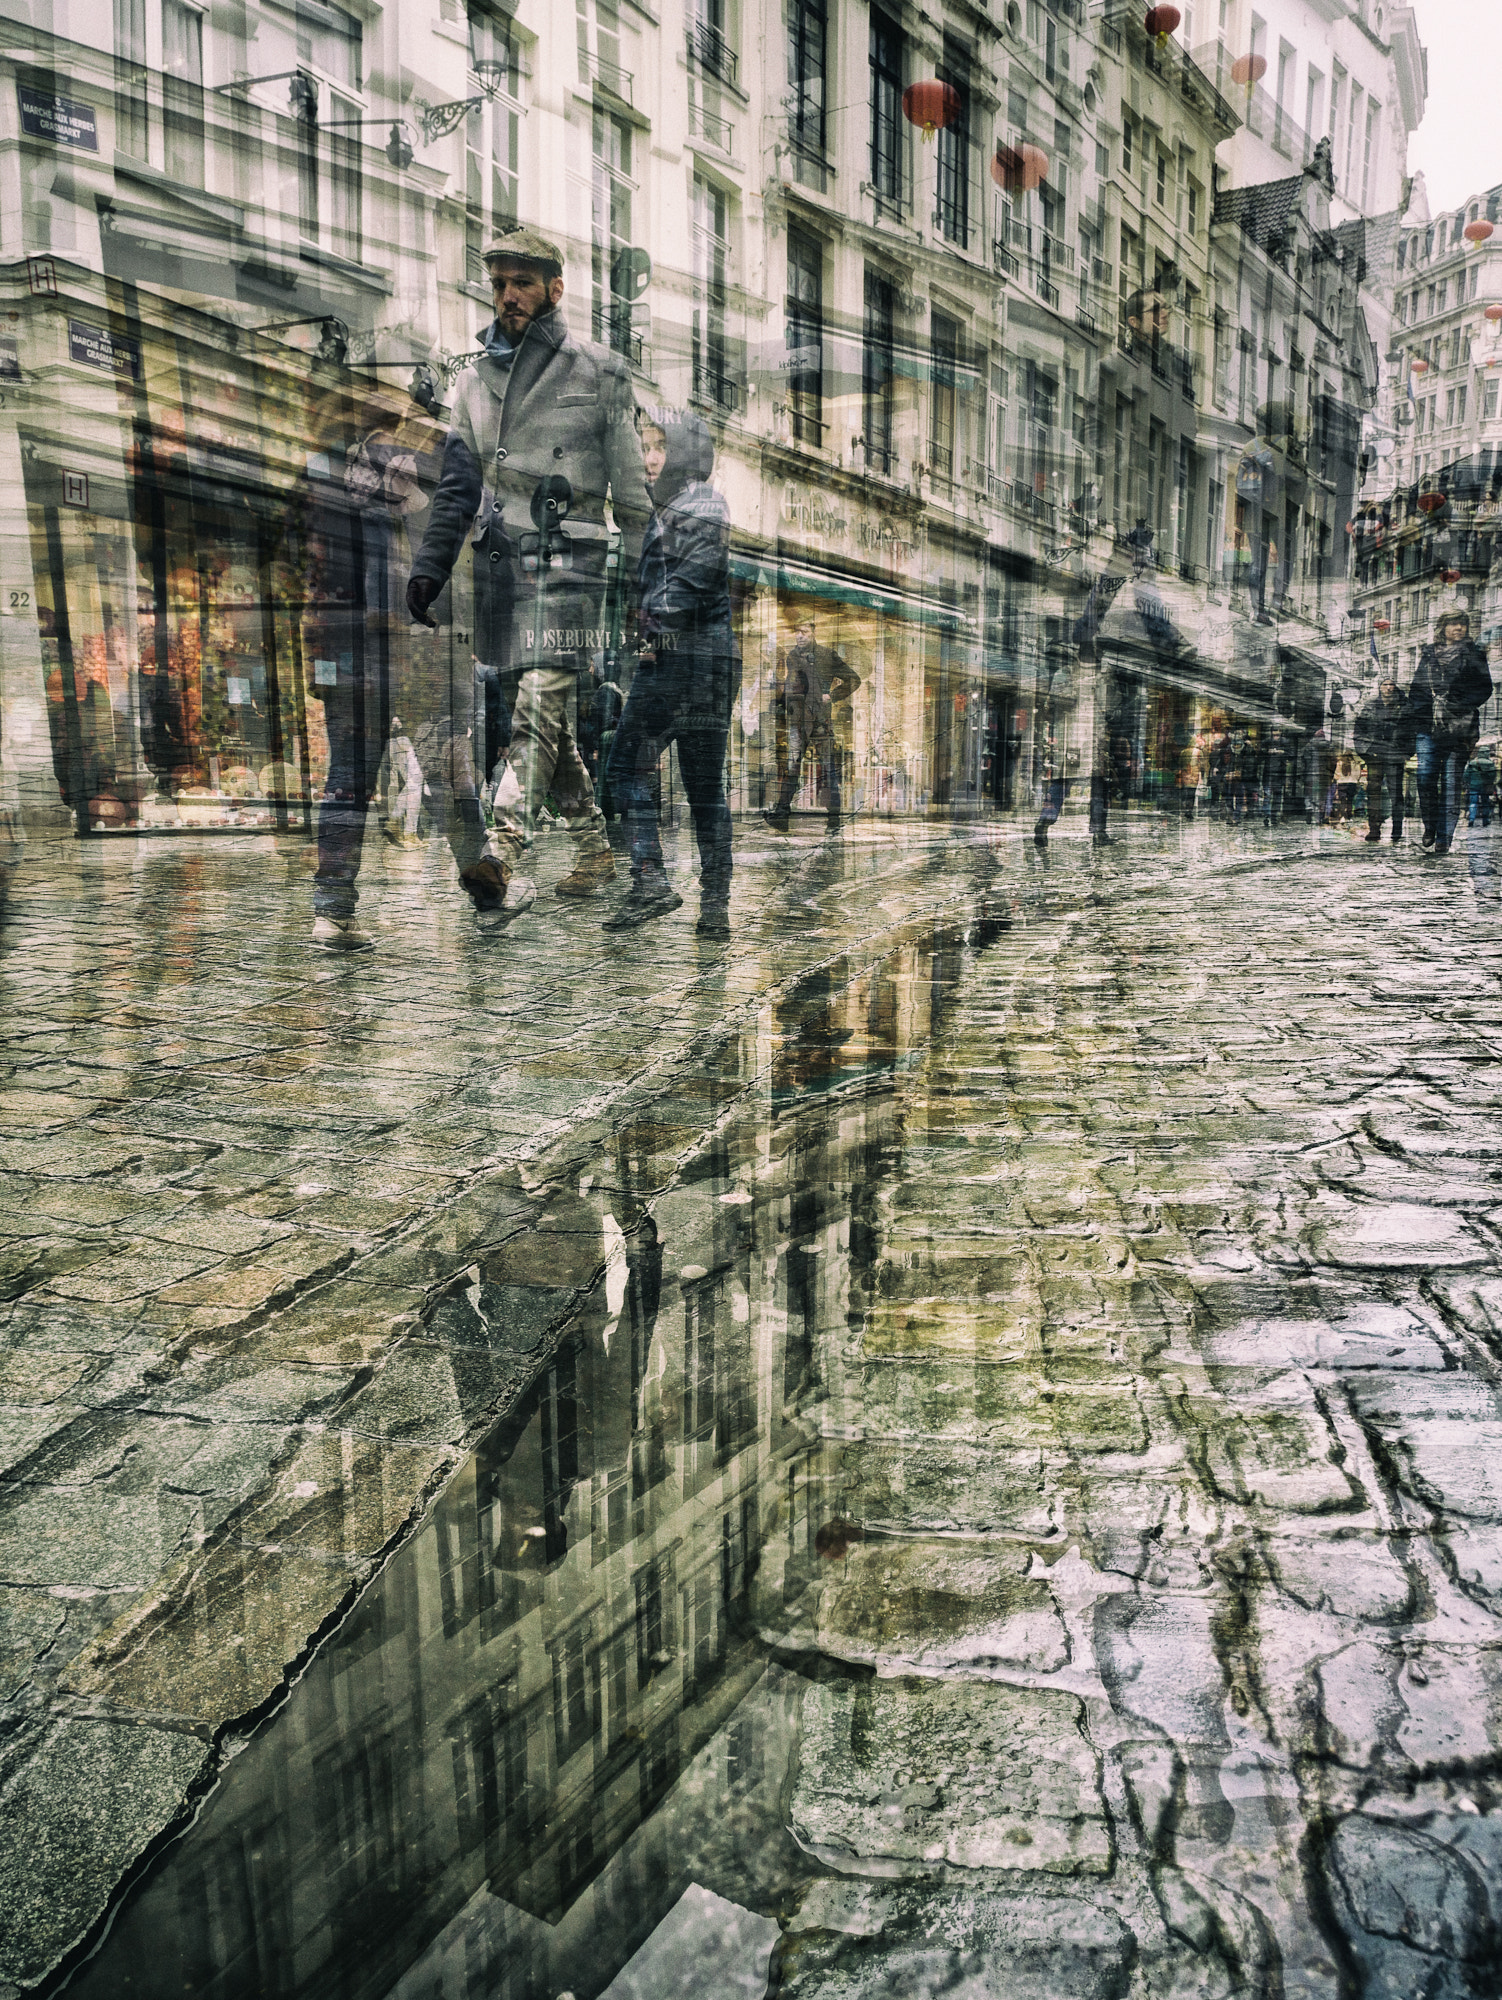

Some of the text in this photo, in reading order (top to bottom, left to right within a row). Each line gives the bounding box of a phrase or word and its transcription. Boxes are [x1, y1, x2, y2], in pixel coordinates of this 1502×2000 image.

[54, 112, 68, 124] AUX
[40, 119, 80, 138] GRASMARKT
[100, 343, 113, 355] AUX
[86, 348, 123, 367] GRASMARKT
[10, 592, 30, 607] 22
[457, 632, 469, 644] 24
